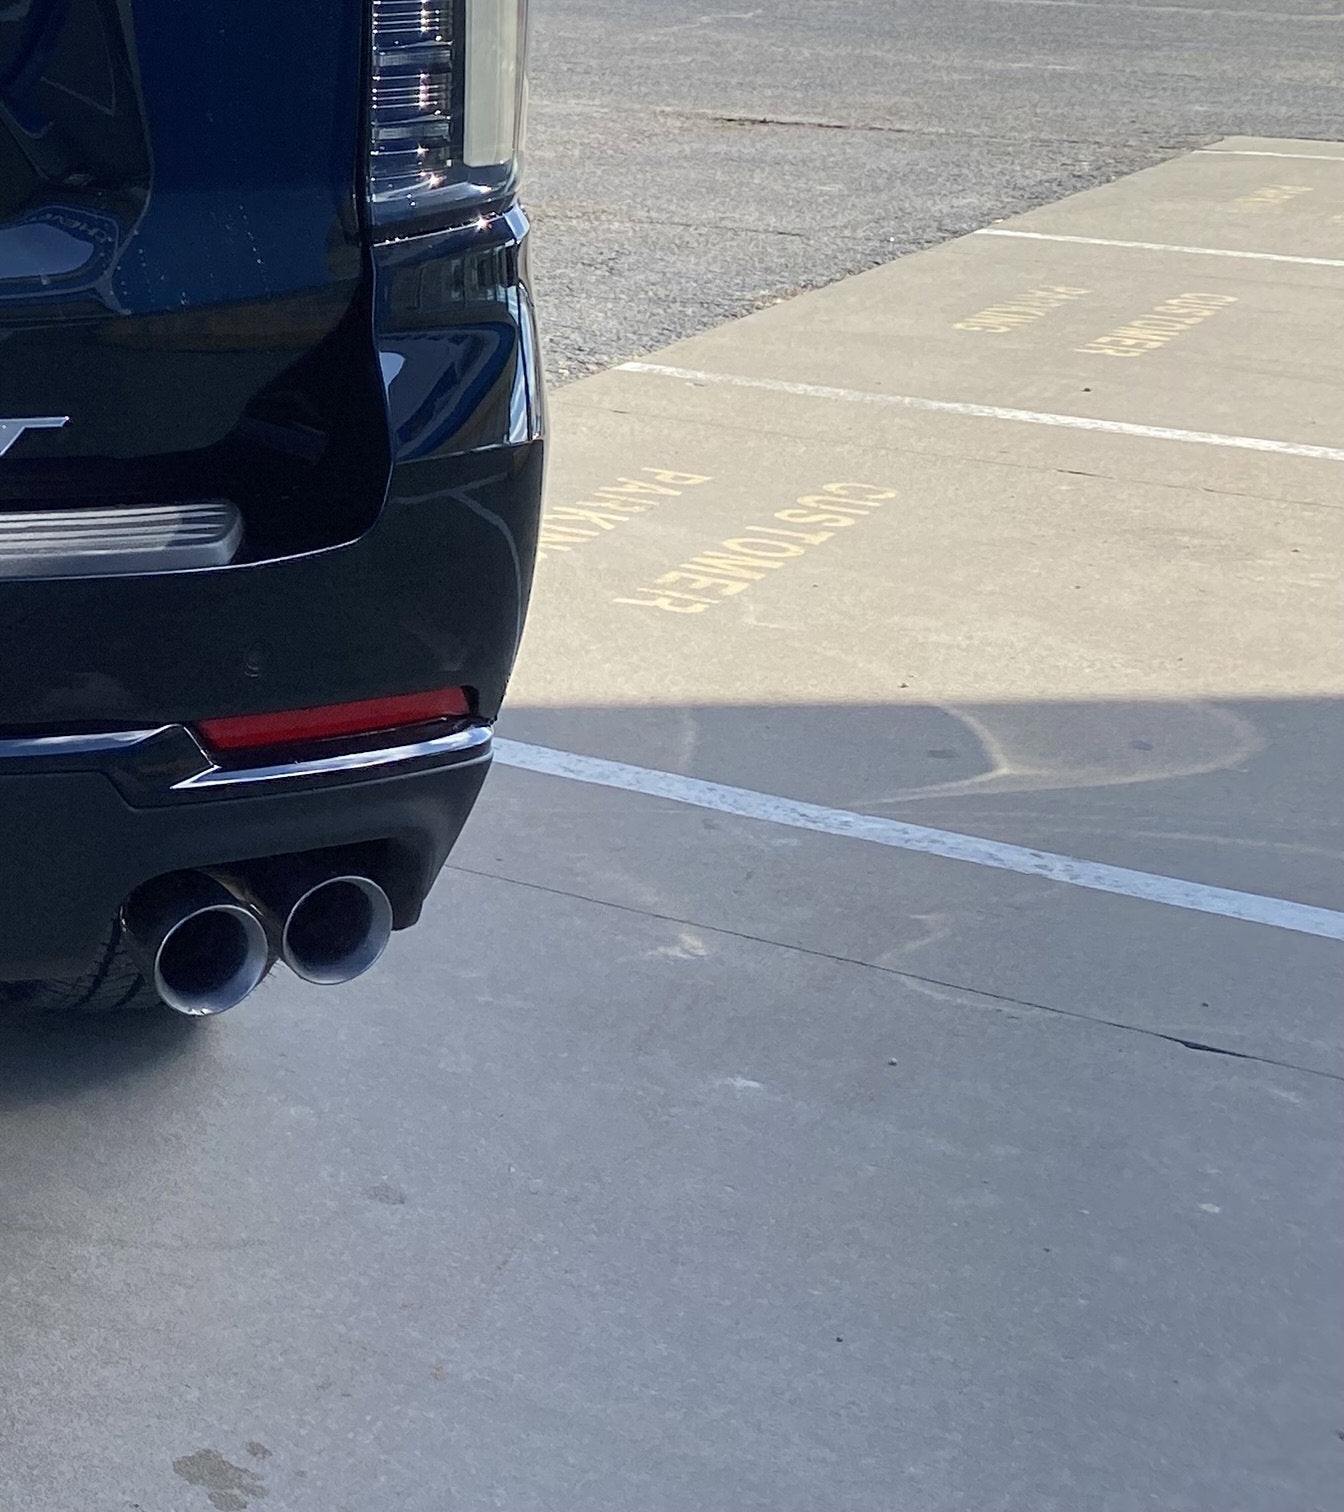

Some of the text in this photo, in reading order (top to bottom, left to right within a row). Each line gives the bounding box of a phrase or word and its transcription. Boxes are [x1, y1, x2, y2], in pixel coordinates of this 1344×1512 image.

[1073, 292, 1239, 357] CUSTOMER
[535, 467, 713, 562] PARKIN
[612, 482, 898, 613] CUSTOMER
